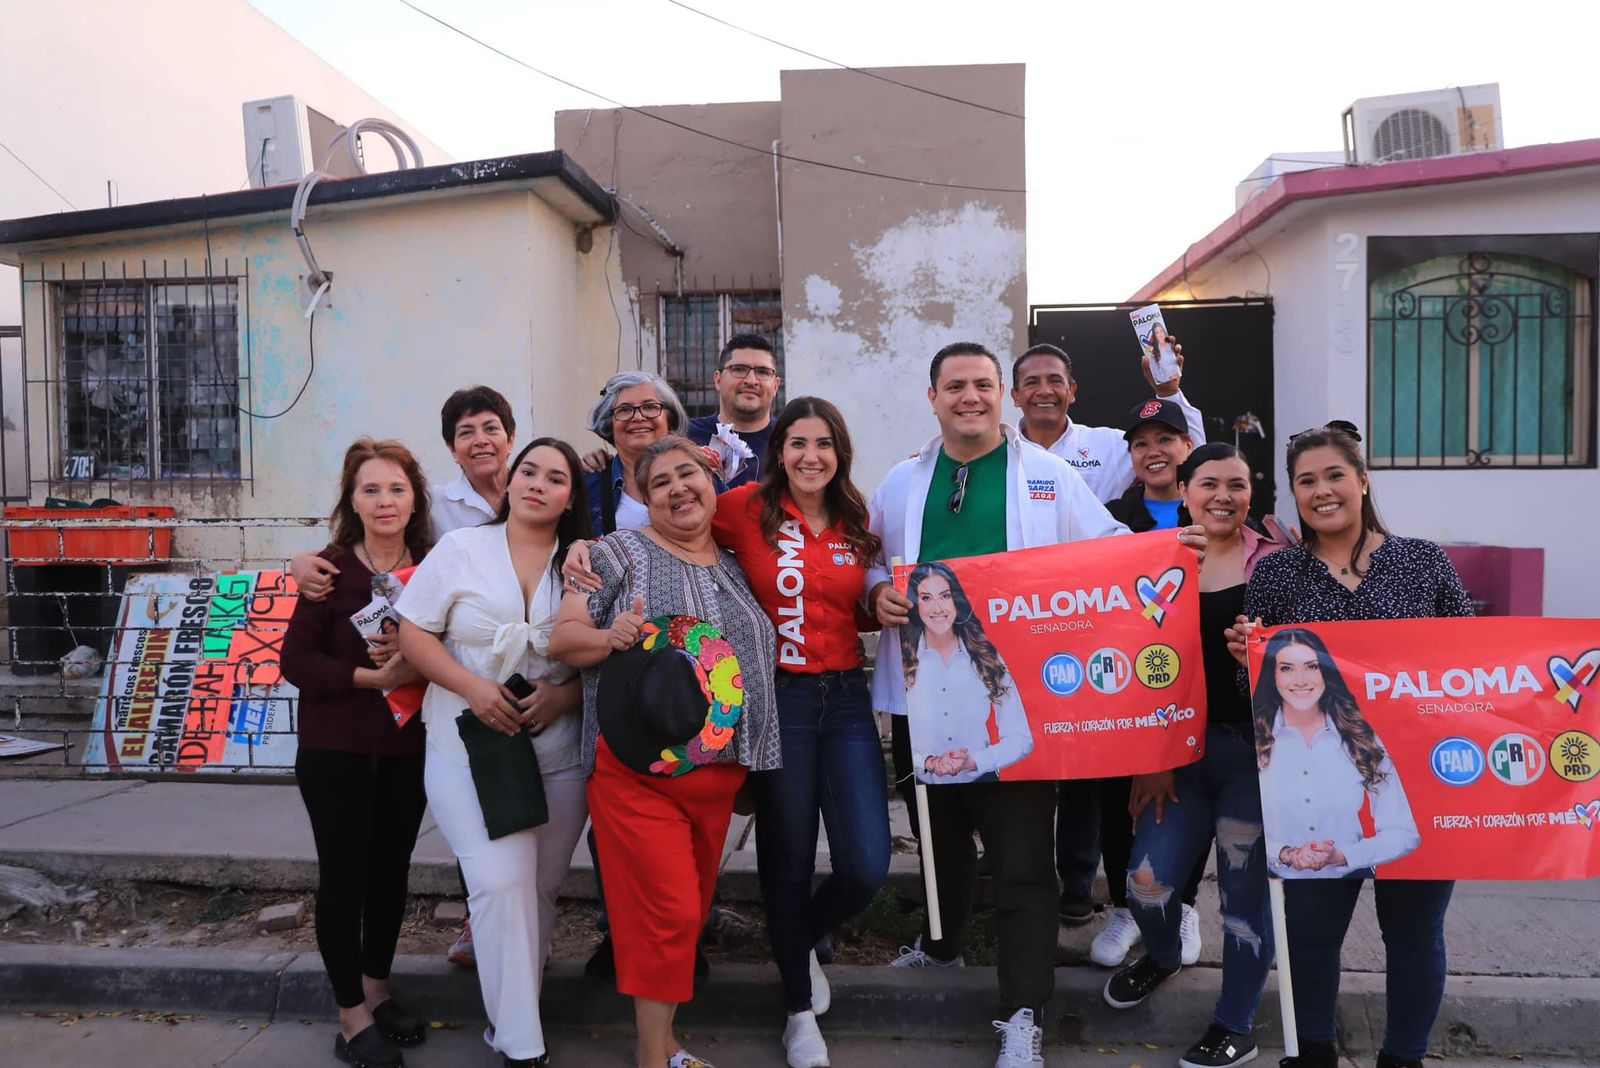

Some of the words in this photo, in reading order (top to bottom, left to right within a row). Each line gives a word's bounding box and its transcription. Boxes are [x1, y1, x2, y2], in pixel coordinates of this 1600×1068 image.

[777, 519, 807, 666] PALOMA
[988, 585, 1132, 623] PALOMA
[357, 604, 389, 627] PALOMA
[1030, 620, 1094, 635] SENADORA
[1048, 663, 1076, 686] PAN
[1091, 656, 1124, 681] PRI
[1147, 672, 1171, 685] PRD
[1364, 664, 1544, 701] PALOMA
[148, 659, 197, 765] CAMARÓN
[1416, 701, 1496, 715] SENADORA
[1044, 721, 1074, 734] FUERZA
[1074, 722, 1081, 732] Y
[1081, 717, 1115, 732] CORAZÓN
[1116, 718, 1134, 730] POR
[121, 733, 147, 757] EL
[1439, 749, 1475, 774] PAN
[1494, 743, 1537, 770] PRI
[1563, 764, 1592, 776] PRD
[1433, 815, 1472, 829] FUERZA
[1473, 815, 1481, 829] Y
[1483, 812, 1525, 828] CORAZÓN
[1527, 813, 1547, 827] POR
